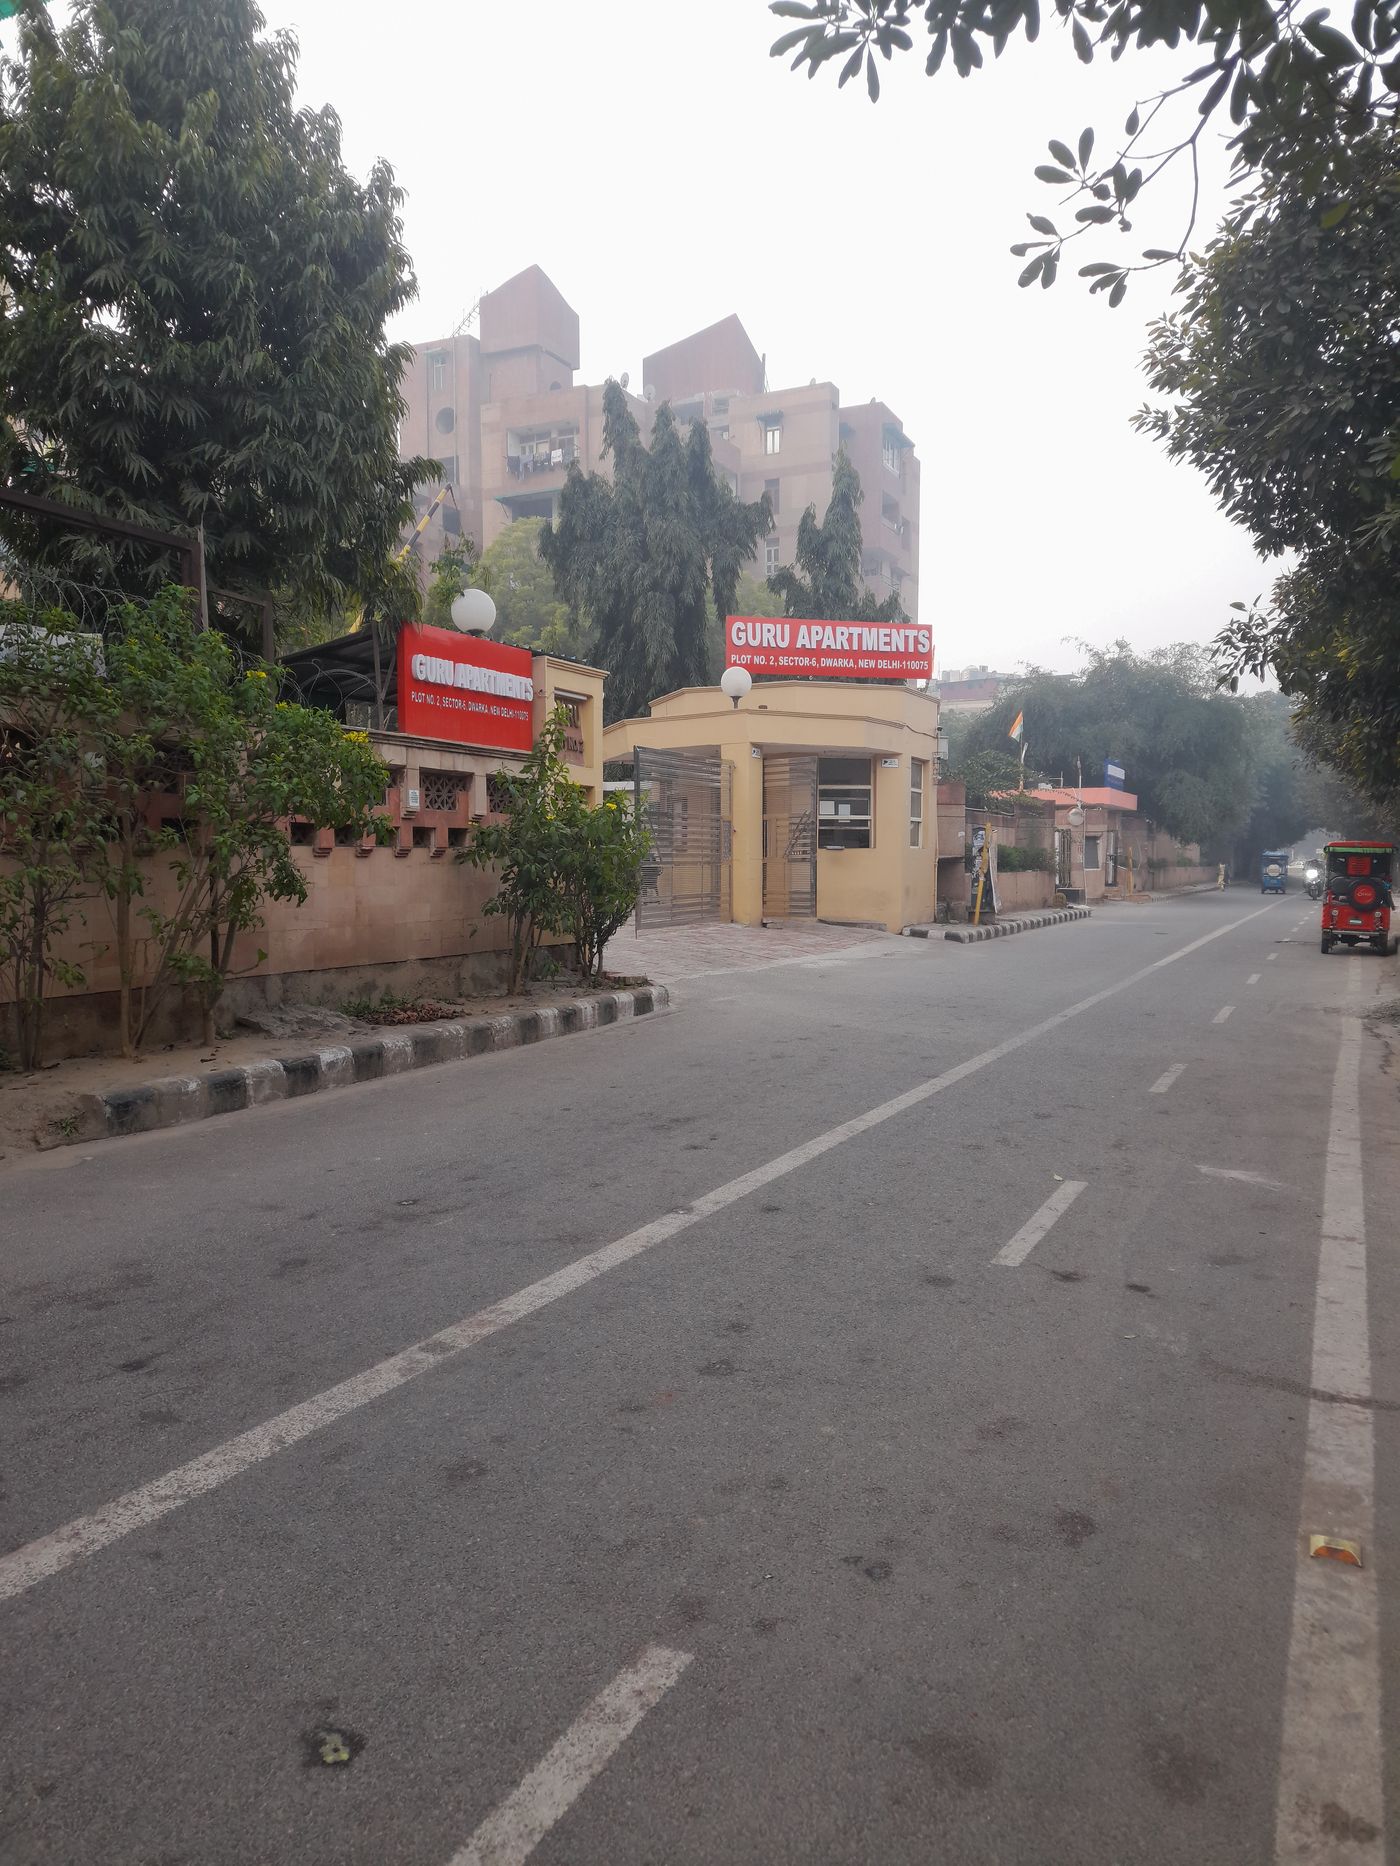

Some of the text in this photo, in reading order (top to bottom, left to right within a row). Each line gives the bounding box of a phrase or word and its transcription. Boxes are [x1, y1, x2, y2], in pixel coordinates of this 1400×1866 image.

[731, 622, 930, 653] GURU APARTMENTS
[731, 654, 929, 671] PLOT NO. 2, SECTOR-6, DWARKA, NEW DELHI-110075
[411, 653, 534, 702] GURU APARTMENTS
[411, 691, 426, 703] PLOT
[426, 694, 437, 705] NO.
[490, 705, 501, 717] NEW
